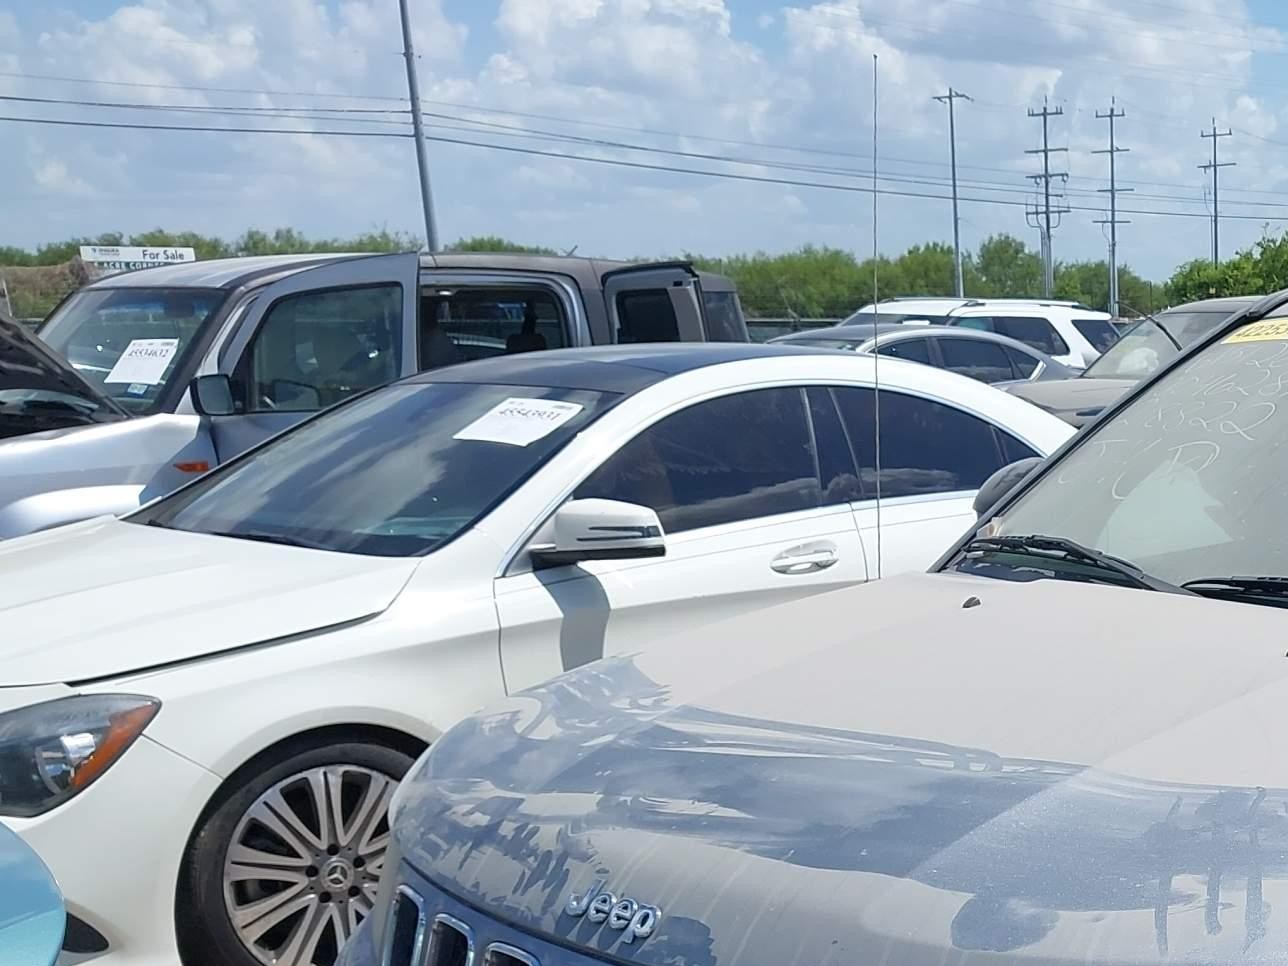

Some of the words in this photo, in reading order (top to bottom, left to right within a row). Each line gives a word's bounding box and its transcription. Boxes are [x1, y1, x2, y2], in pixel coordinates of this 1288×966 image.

[142, 250, 160, 260] For
[163, 250, 185, 260] Sale
[565, 881, 662, 944] Jeep
